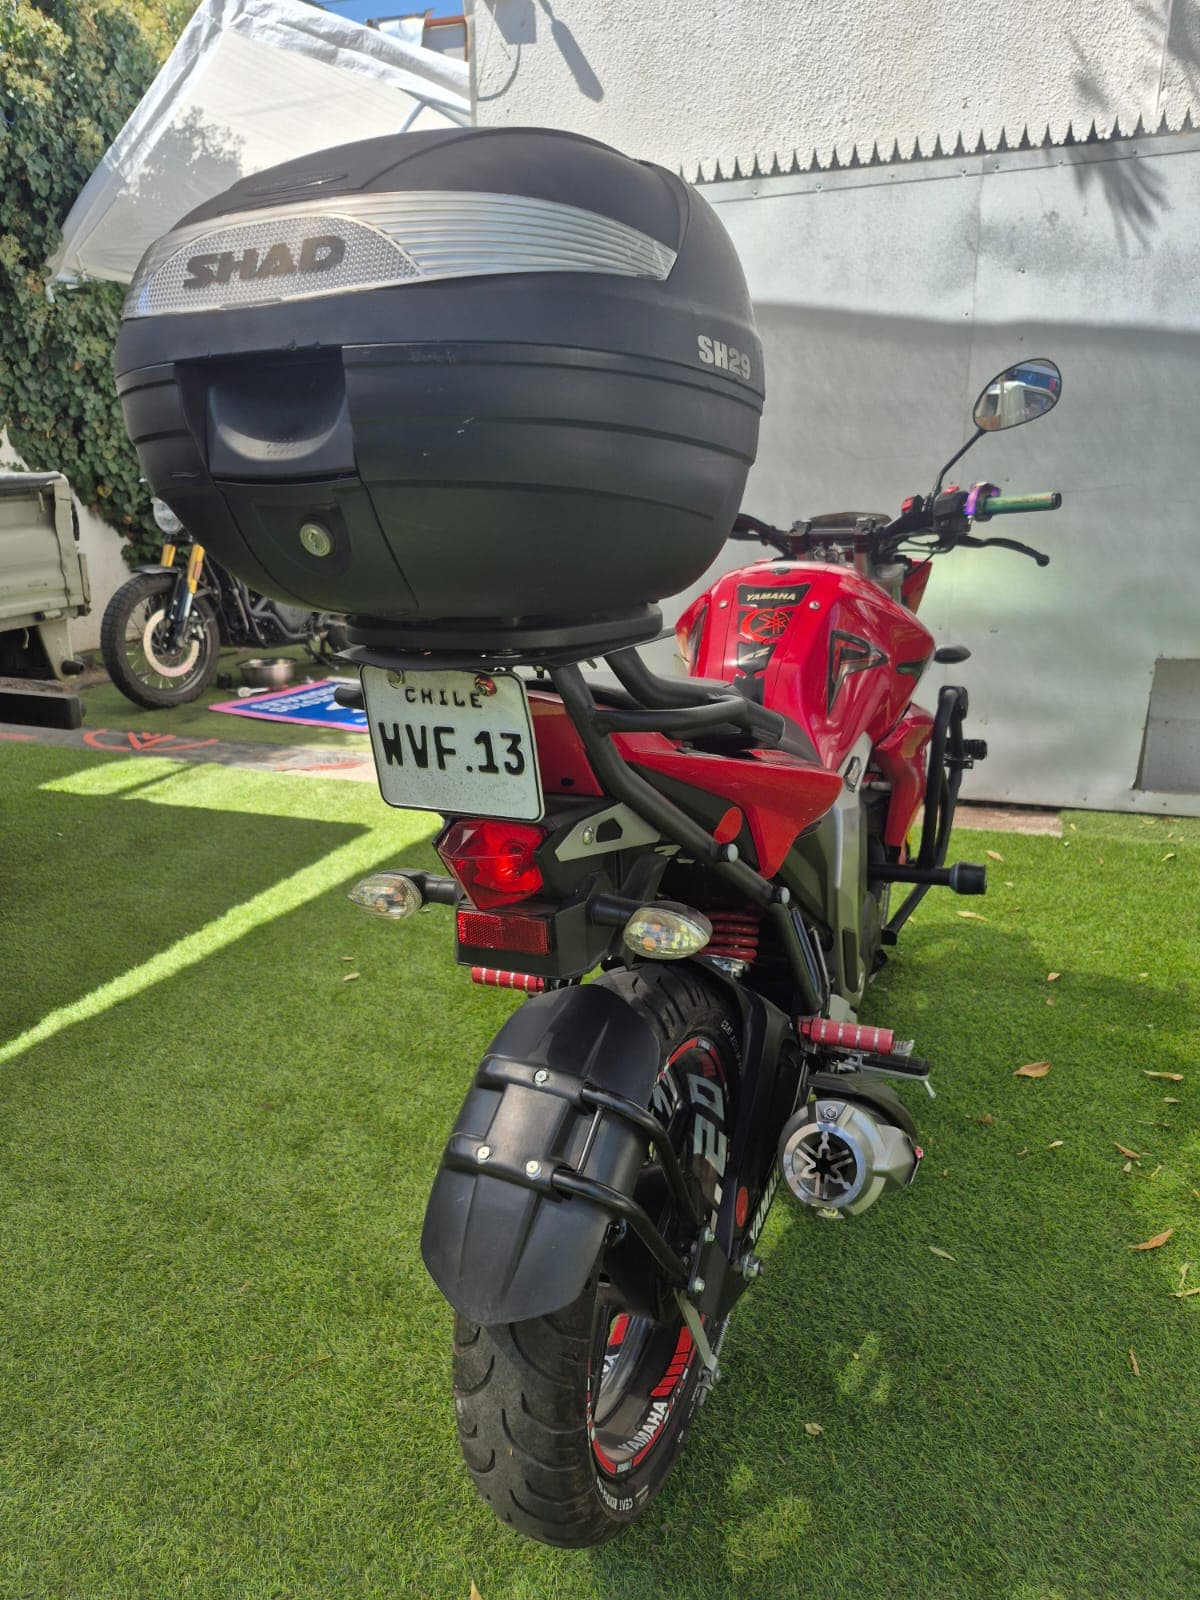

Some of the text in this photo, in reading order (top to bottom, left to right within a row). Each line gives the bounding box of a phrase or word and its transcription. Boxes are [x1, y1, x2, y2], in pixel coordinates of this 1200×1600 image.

[183, 235, 346, 288] SHAD
[697, 334, 751, 380] SH29
[746, 592, 796, 601] YAMAHA
[405, 688, 483, 708] CHILE
[378, 721, 525, 776] WVF.13
[617, 1401, 668, 1453] YAMAHA
